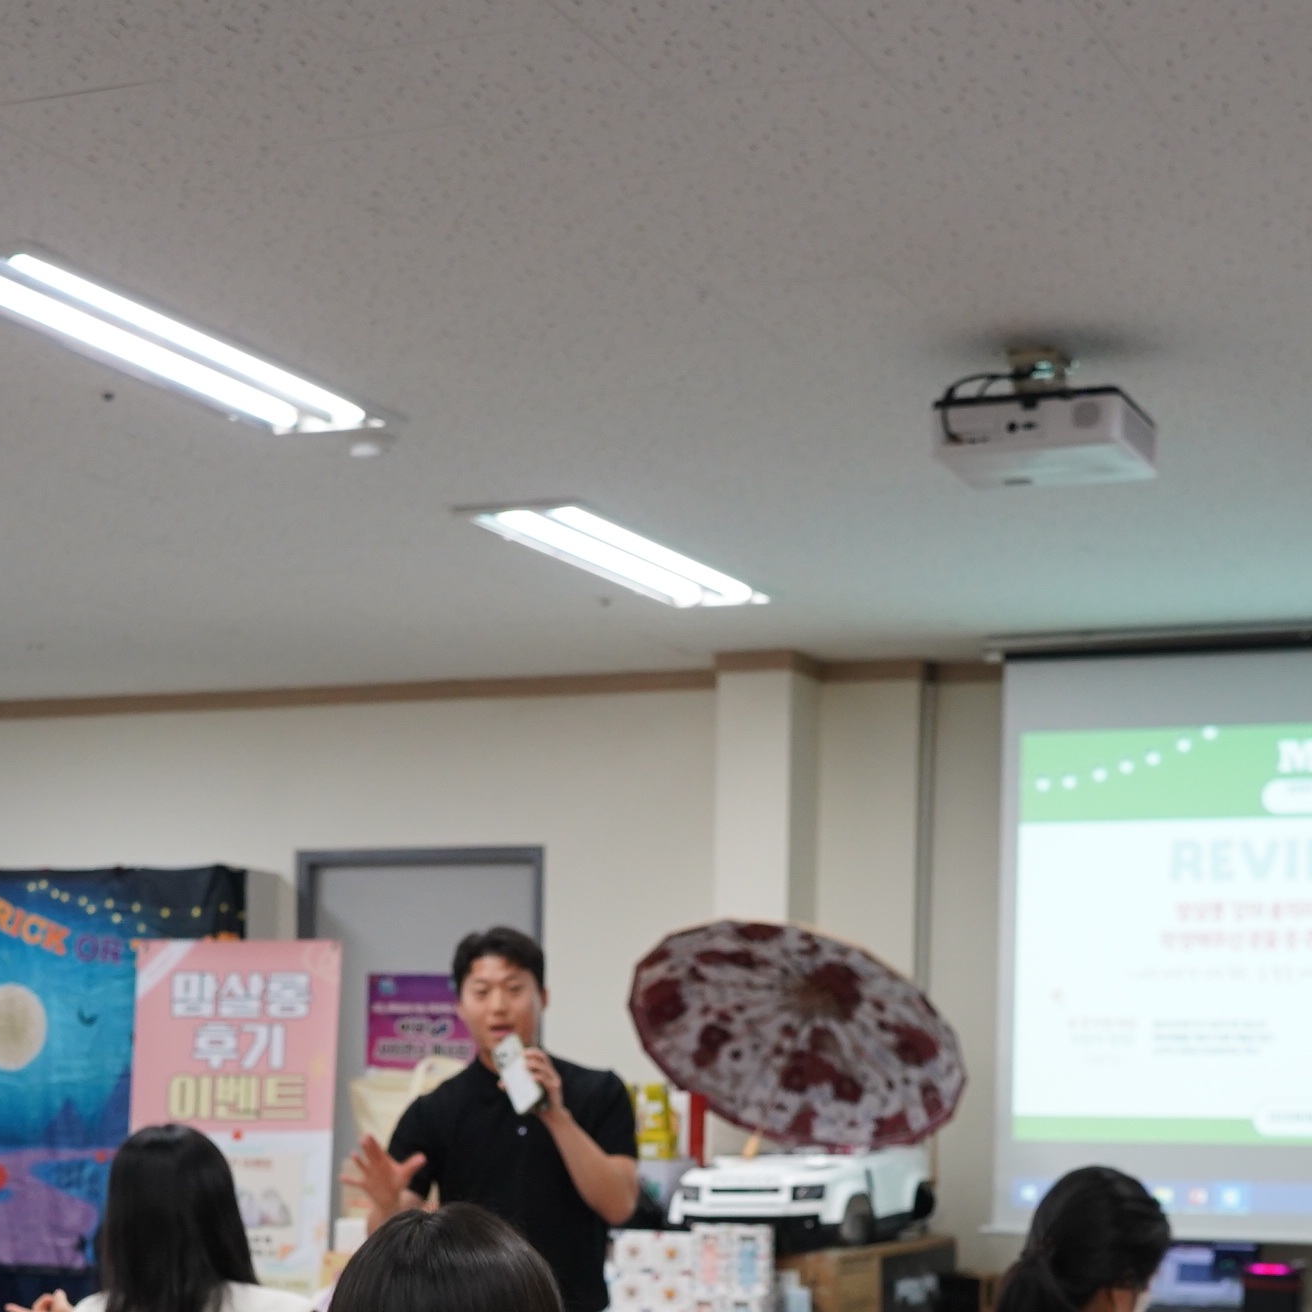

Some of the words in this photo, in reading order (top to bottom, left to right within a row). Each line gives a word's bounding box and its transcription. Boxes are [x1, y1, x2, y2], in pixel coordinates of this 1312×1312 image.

[76, 934, 124, 965] OR
[171, 972, 311, 1019] 맘살롱
[193, 1022, 286, 1070] 후기
[168, 1074, 307, 1121] 이벤트
